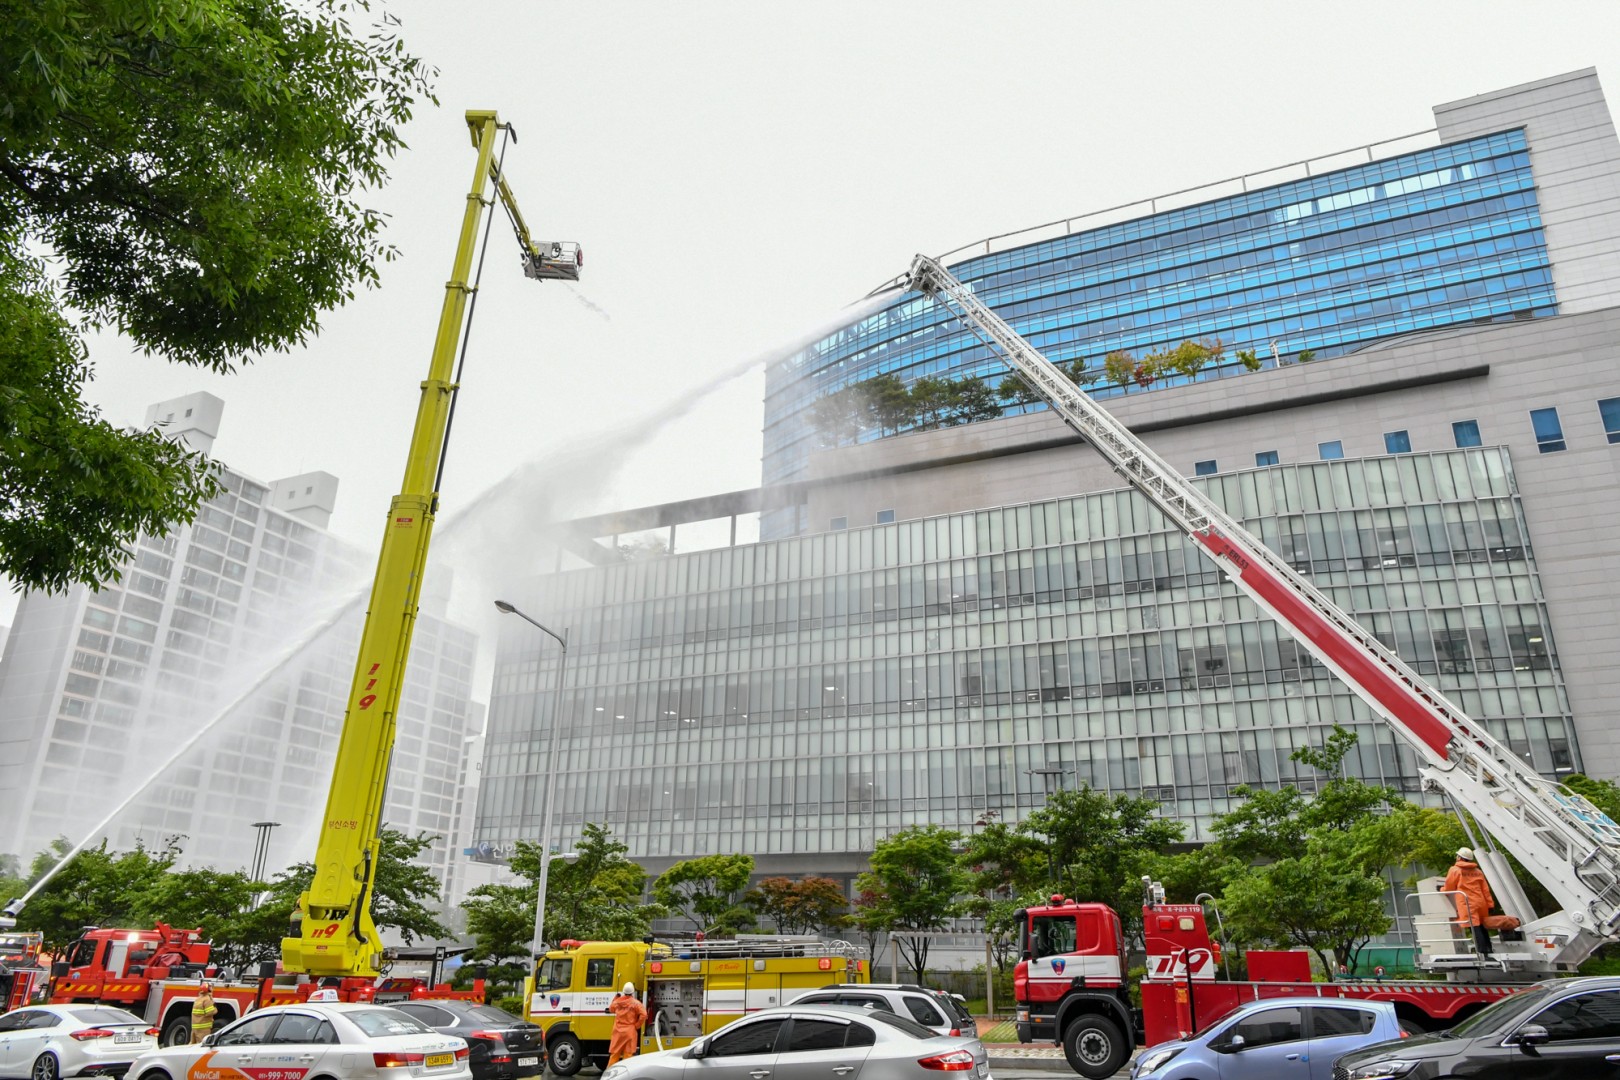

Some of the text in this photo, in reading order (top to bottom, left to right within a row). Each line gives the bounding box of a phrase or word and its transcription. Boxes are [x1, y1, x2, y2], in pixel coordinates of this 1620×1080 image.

[358, 663, 380, 710] 119
[311, 923, 340, 938] 119
[1155, 949, 1210, 976] 119
[193, 1071, 220, 1080] NaviCall
